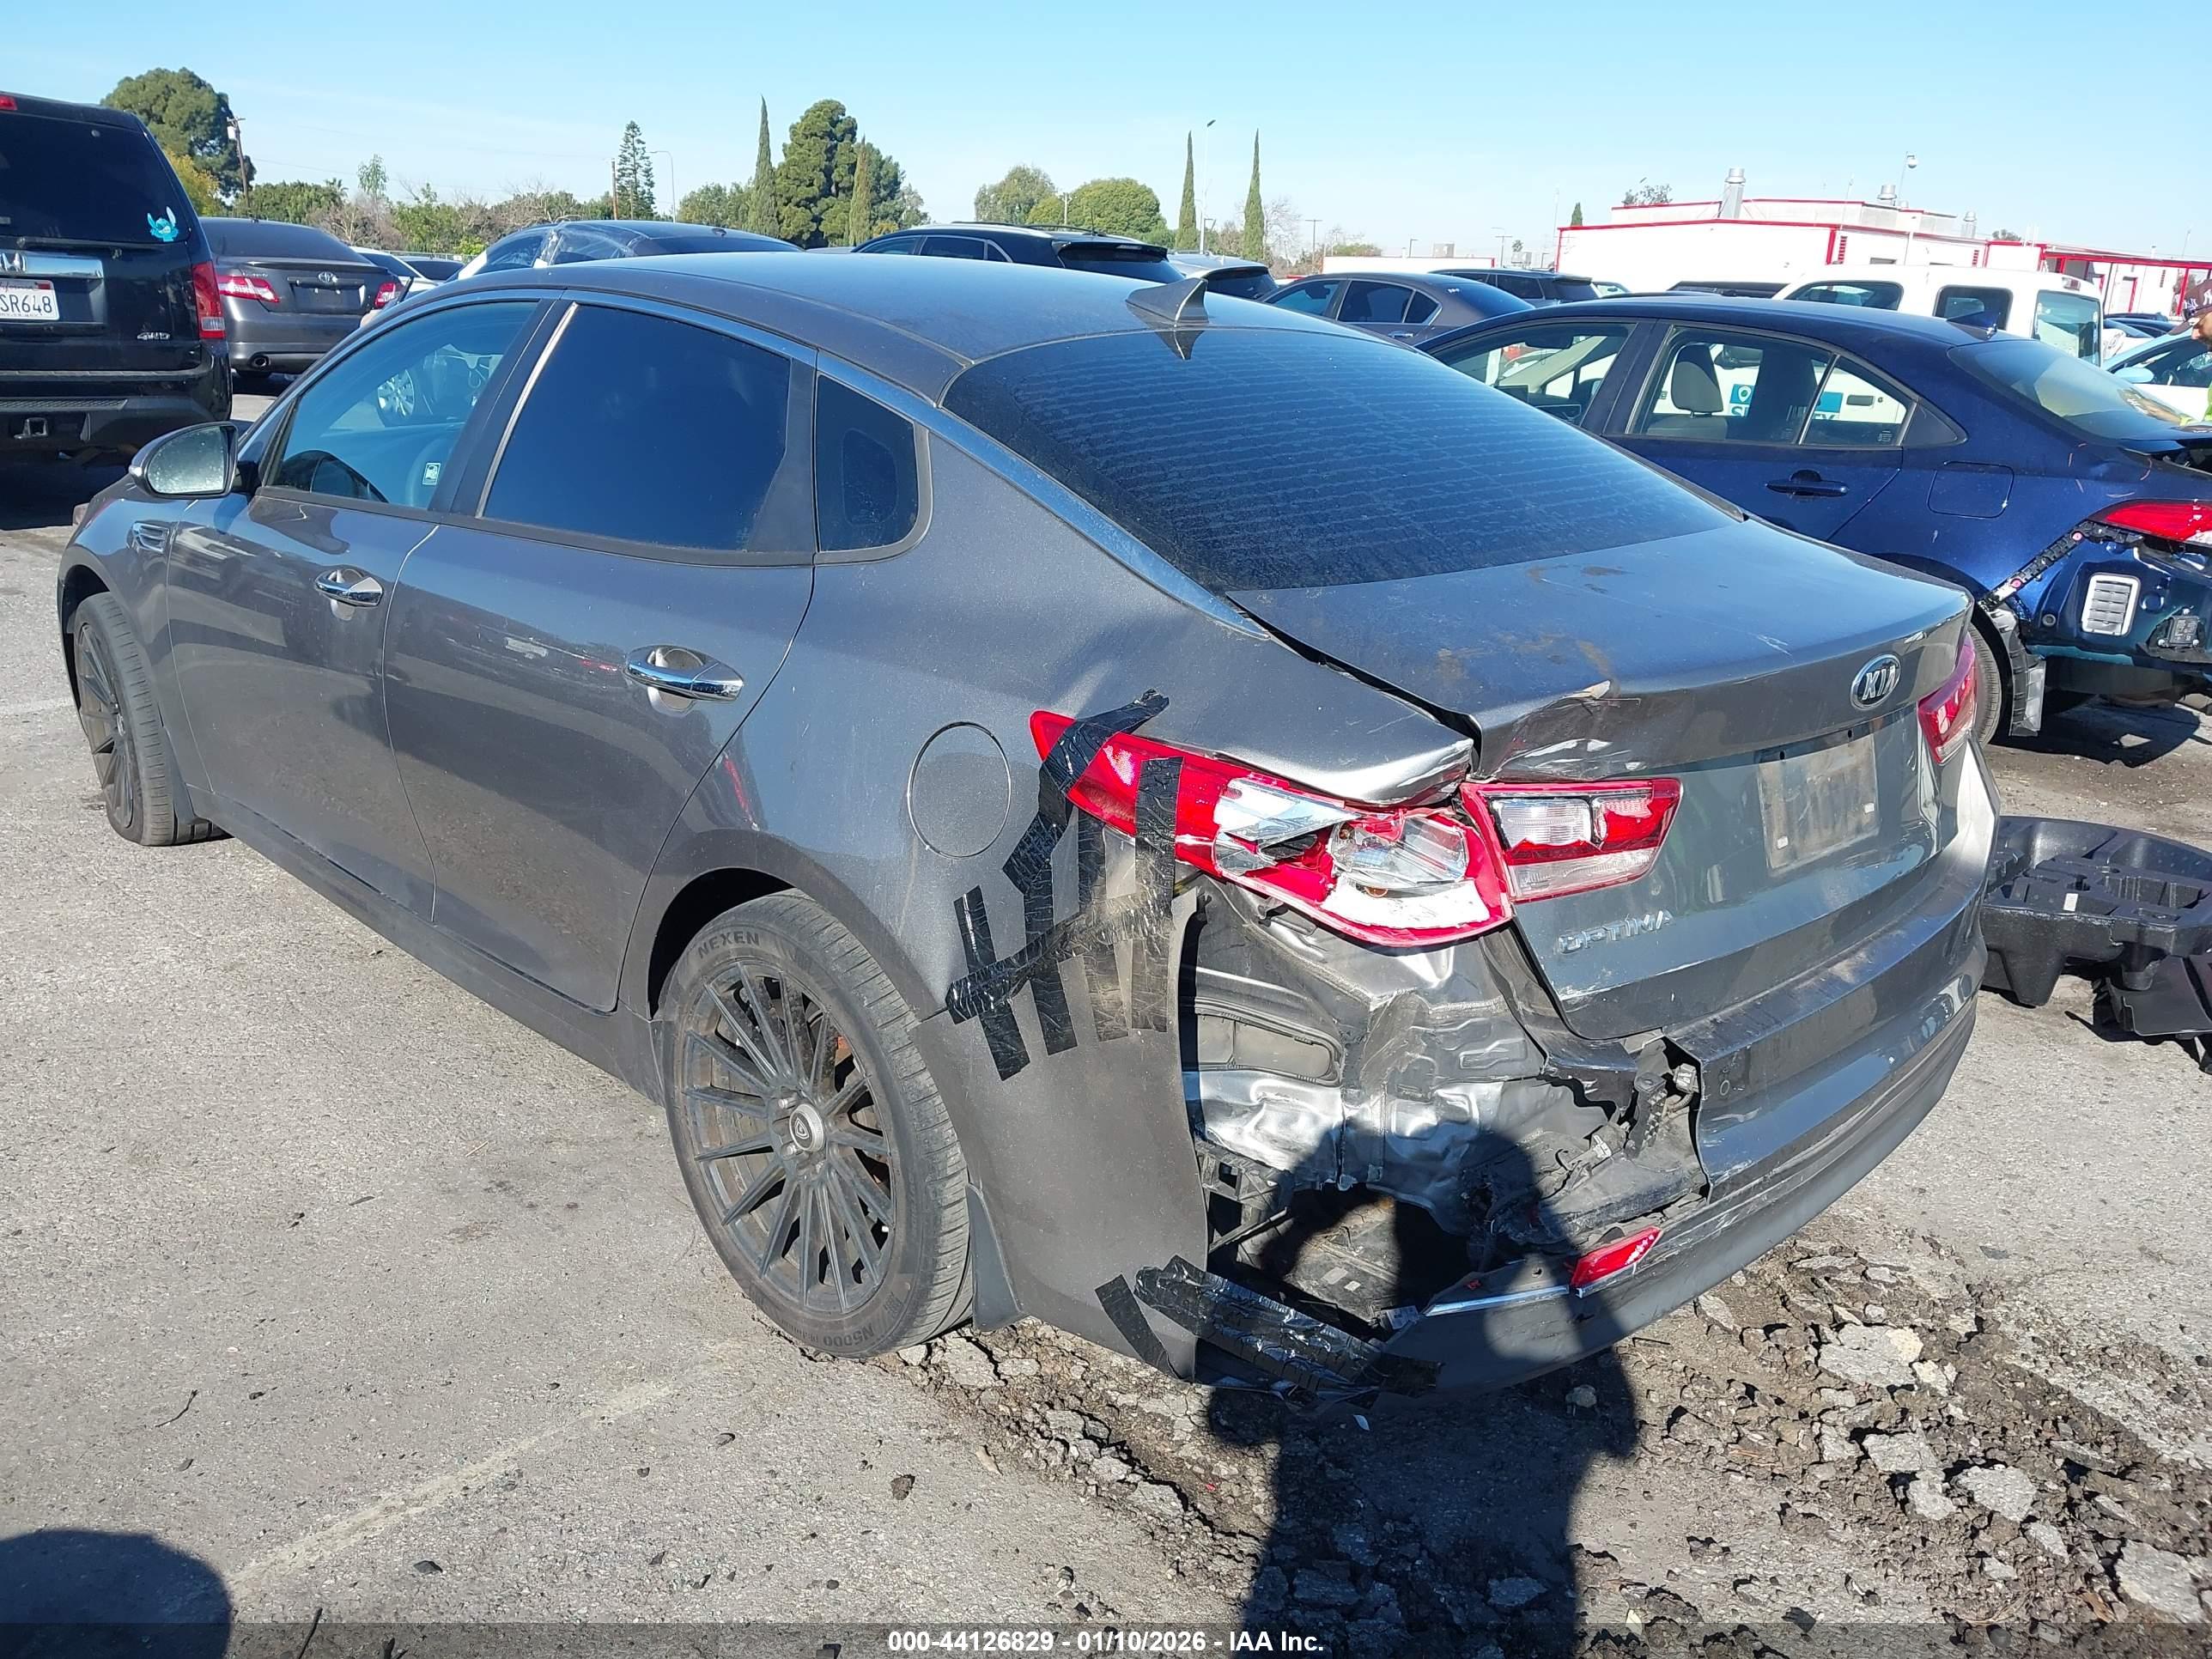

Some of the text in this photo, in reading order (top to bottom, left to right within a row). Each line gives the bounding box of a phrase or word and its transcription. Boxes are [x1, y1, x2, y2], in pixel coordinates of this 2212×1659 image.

[1862, 664, 1896, 701] KIA
[697, 931, 760, 959] NEXEN
[1557, 909, 1674, 955] OPTIMA
